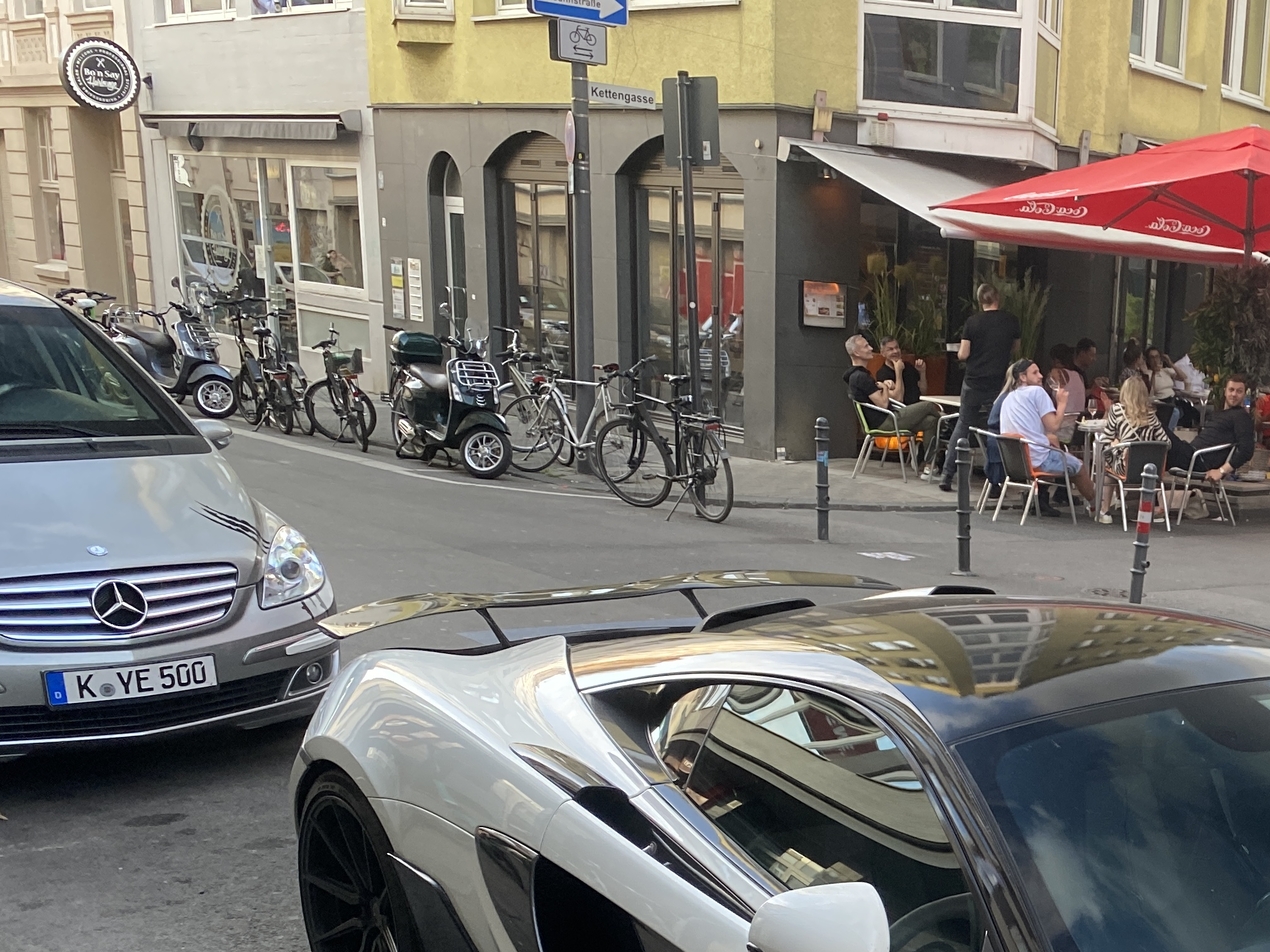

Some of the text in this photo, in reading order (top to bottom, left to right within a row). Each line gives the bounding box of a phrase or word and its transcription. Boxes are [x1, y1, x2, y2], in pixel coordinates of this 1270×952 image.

[591, 86, 654, 105] Kettengasse
[76, 660, 207, 699] K YE 500
[54, 691, 62, 699] D
